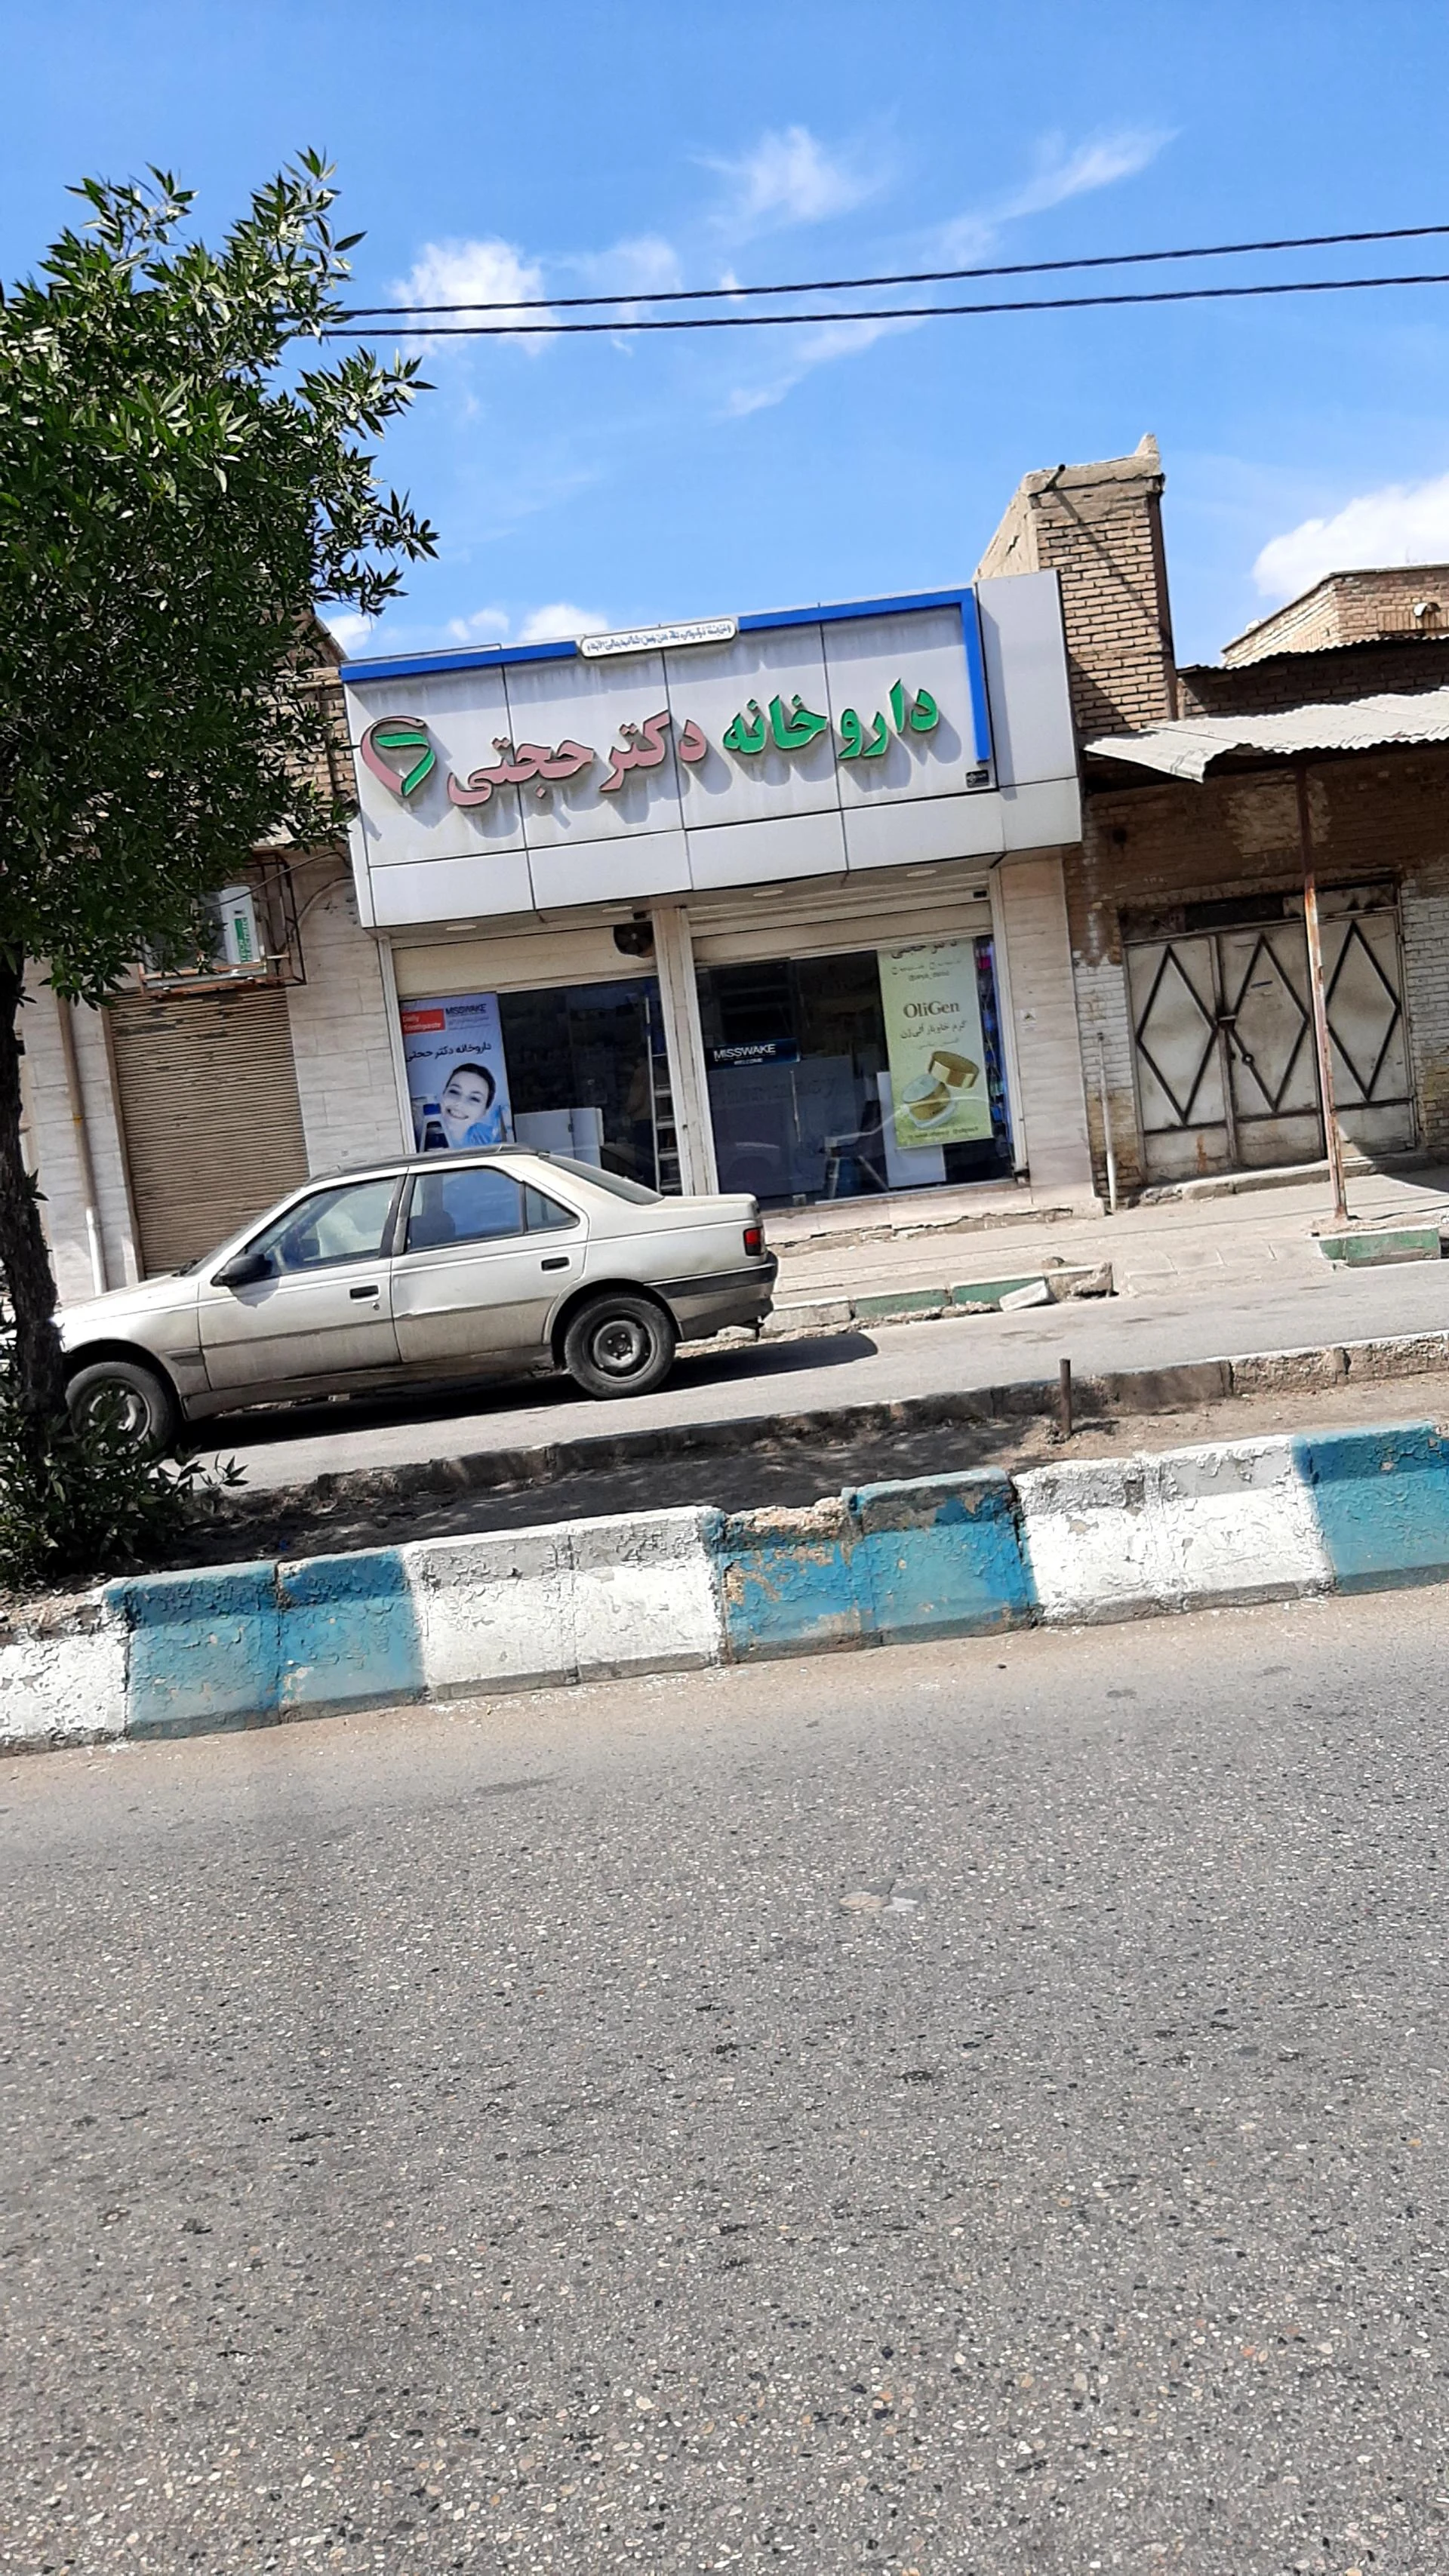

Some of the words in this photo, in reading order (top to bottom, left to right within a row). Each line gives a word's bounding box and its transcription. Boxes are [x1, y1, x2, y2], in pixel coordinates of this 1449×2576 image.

[722, 678, 939, 760] داروخانه
[598, 709, 707, 792] دکتر
[446, 739, 595, 807] حجتی
[903, 1000, 961, 1019] OliGen
[435, 1045, 454, 1060] دکتر
[456, 1042, 491, 1055] داروخانه
[713, 1043, 776, 1060] MISSWAKE
